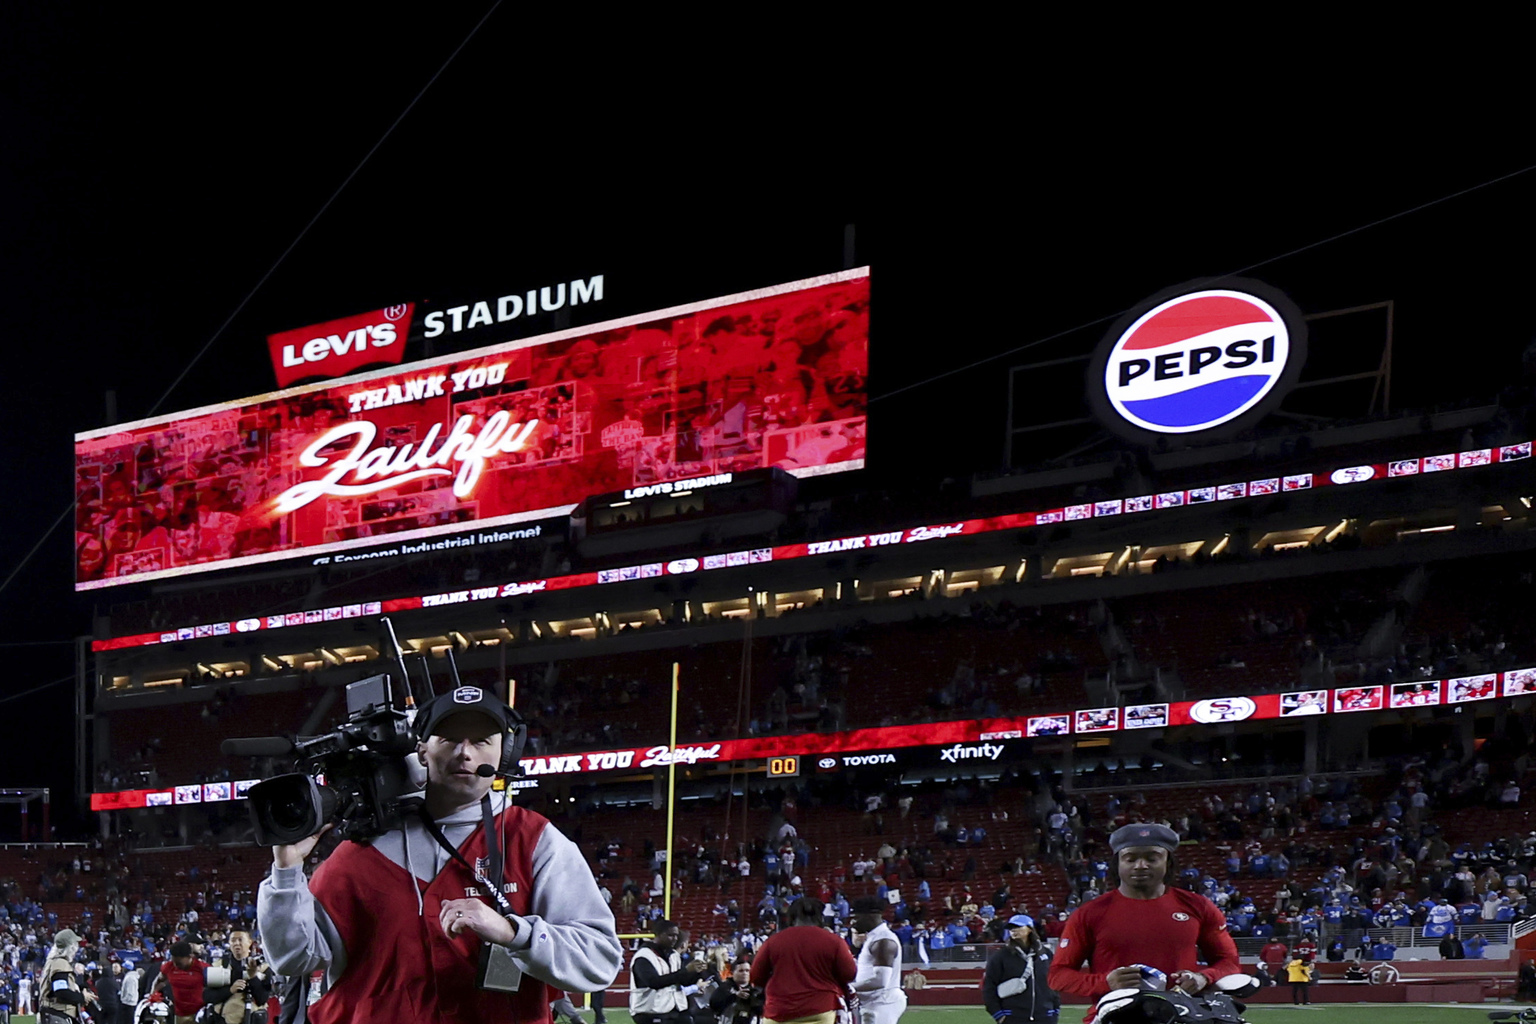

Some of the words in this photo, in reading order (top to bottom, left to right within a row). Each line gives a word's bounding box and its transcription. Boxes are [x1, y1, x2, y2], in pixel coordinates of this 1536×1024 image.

[424, 274, 604, 338] STADIUM
[1118, 335, 1275, 387] PEPSI
[348, 375, 447, 413] THANK
[452, 362, 509, 392] YOU
[674, 473, 733, 491] STADIUM
[479, 525, 542, 544] Internet
[808, 536, 867, 555] THANK
[869, 531, 904, 546] YOU
[422, 590, 469, 607] THANK
[471, 587, 499, 601] YOU
[587, 750, 635, 771] YOU
[640, 744, 722, 768] Faithful
[842, 753, 897, 767] TOYOTA
[940, 742, 1005, 763] xfinity
[770, 757, 797, 775] 00
[464, 882, 519, 897] TELON
